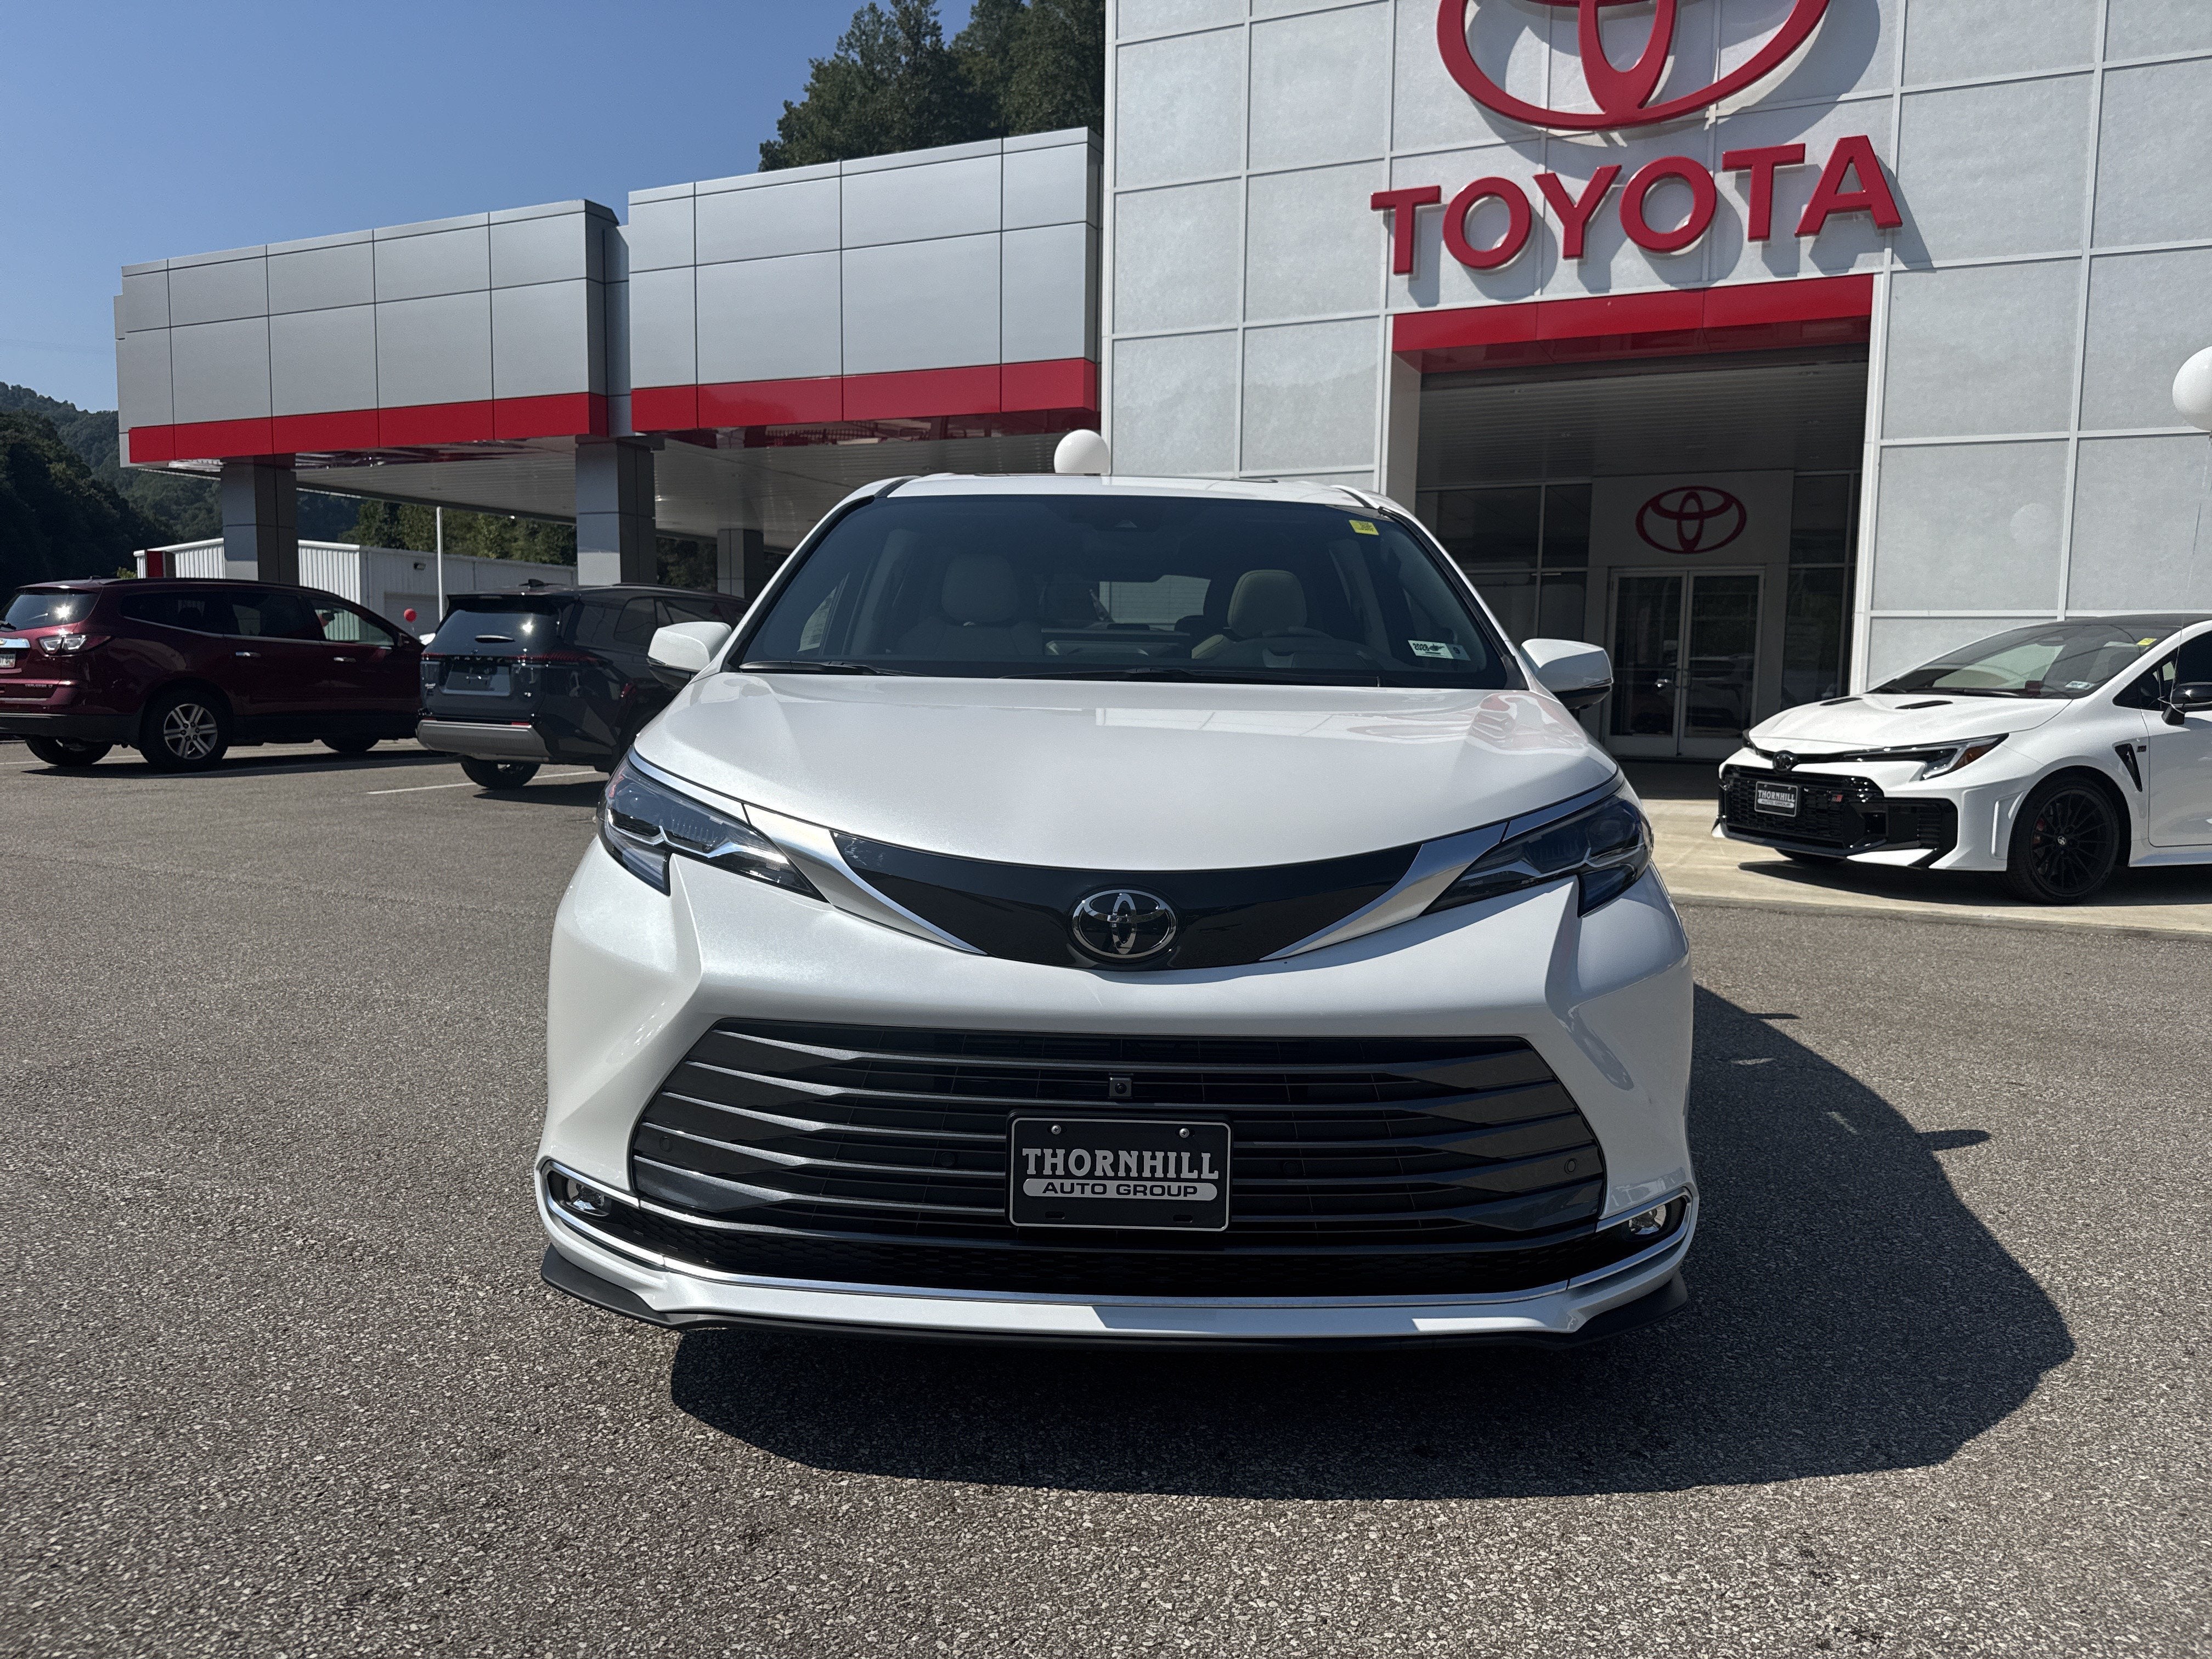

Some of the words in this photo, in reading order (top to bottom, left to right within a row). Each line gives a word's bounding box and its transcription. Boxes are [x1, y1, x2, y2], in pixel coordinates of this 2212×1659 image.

[1370, 134, 1903, 275] TOYOTA
[1758, 789, 1795, 802] THORNHILL
[1022, 1148, 1219, 1180] THORNHILL
[1042, 1182, 1107, 1195] AUTO
[1116, 1183, 1198, 1198] GROUP
